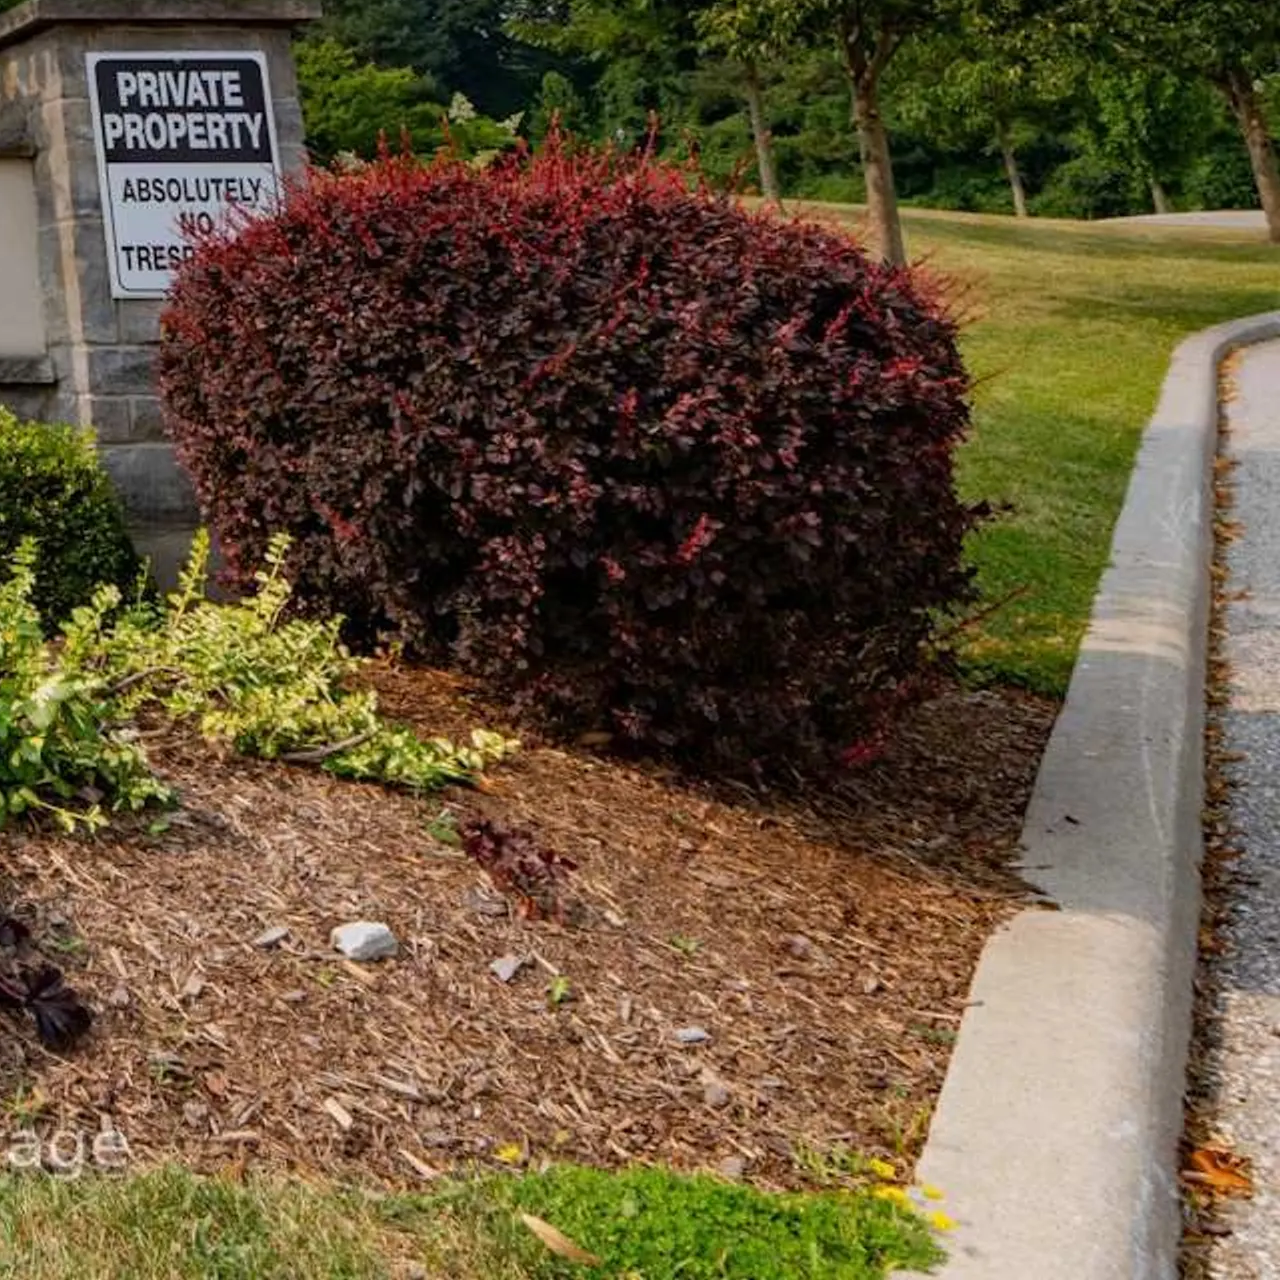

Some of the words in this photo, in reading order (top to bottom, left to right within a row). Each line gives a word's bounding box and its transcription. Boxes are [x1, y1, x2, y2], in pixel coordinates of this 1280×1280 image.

[116, 71, 244, 107] PRIVATE
[103, 112, 263, 150] PROPERTY
[122, 177, 262, 203] ABSOLUTELY
